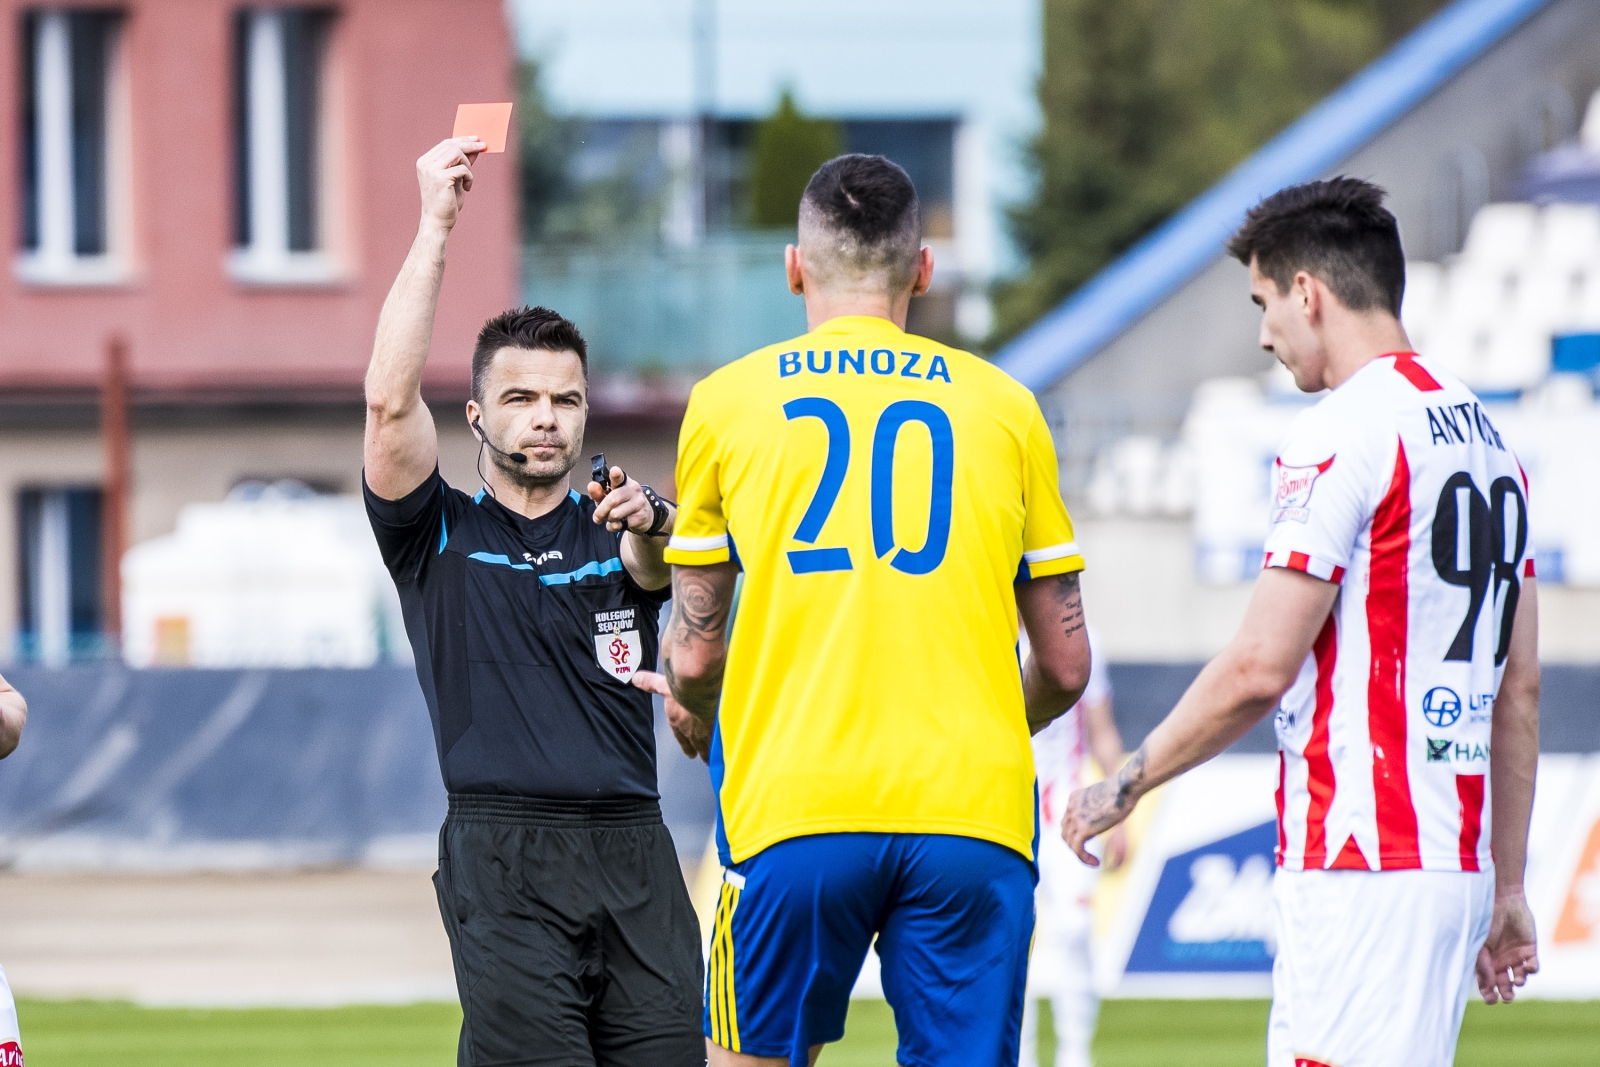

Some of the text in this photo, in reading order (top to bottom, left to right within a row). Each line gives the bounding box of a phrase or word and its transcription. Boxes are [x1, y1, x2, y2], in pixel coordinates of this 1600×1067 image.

[779, 349, 952, 384] BUNOZA
[782, 396, 954, 576] 20
[1431, 470, 1528, 668] 98
[595, 608, 635, 623] KOLEGIUM
[597, 618, 634, 634] SĘDZIÓW
[615, 665, 631, 675] PZPN
